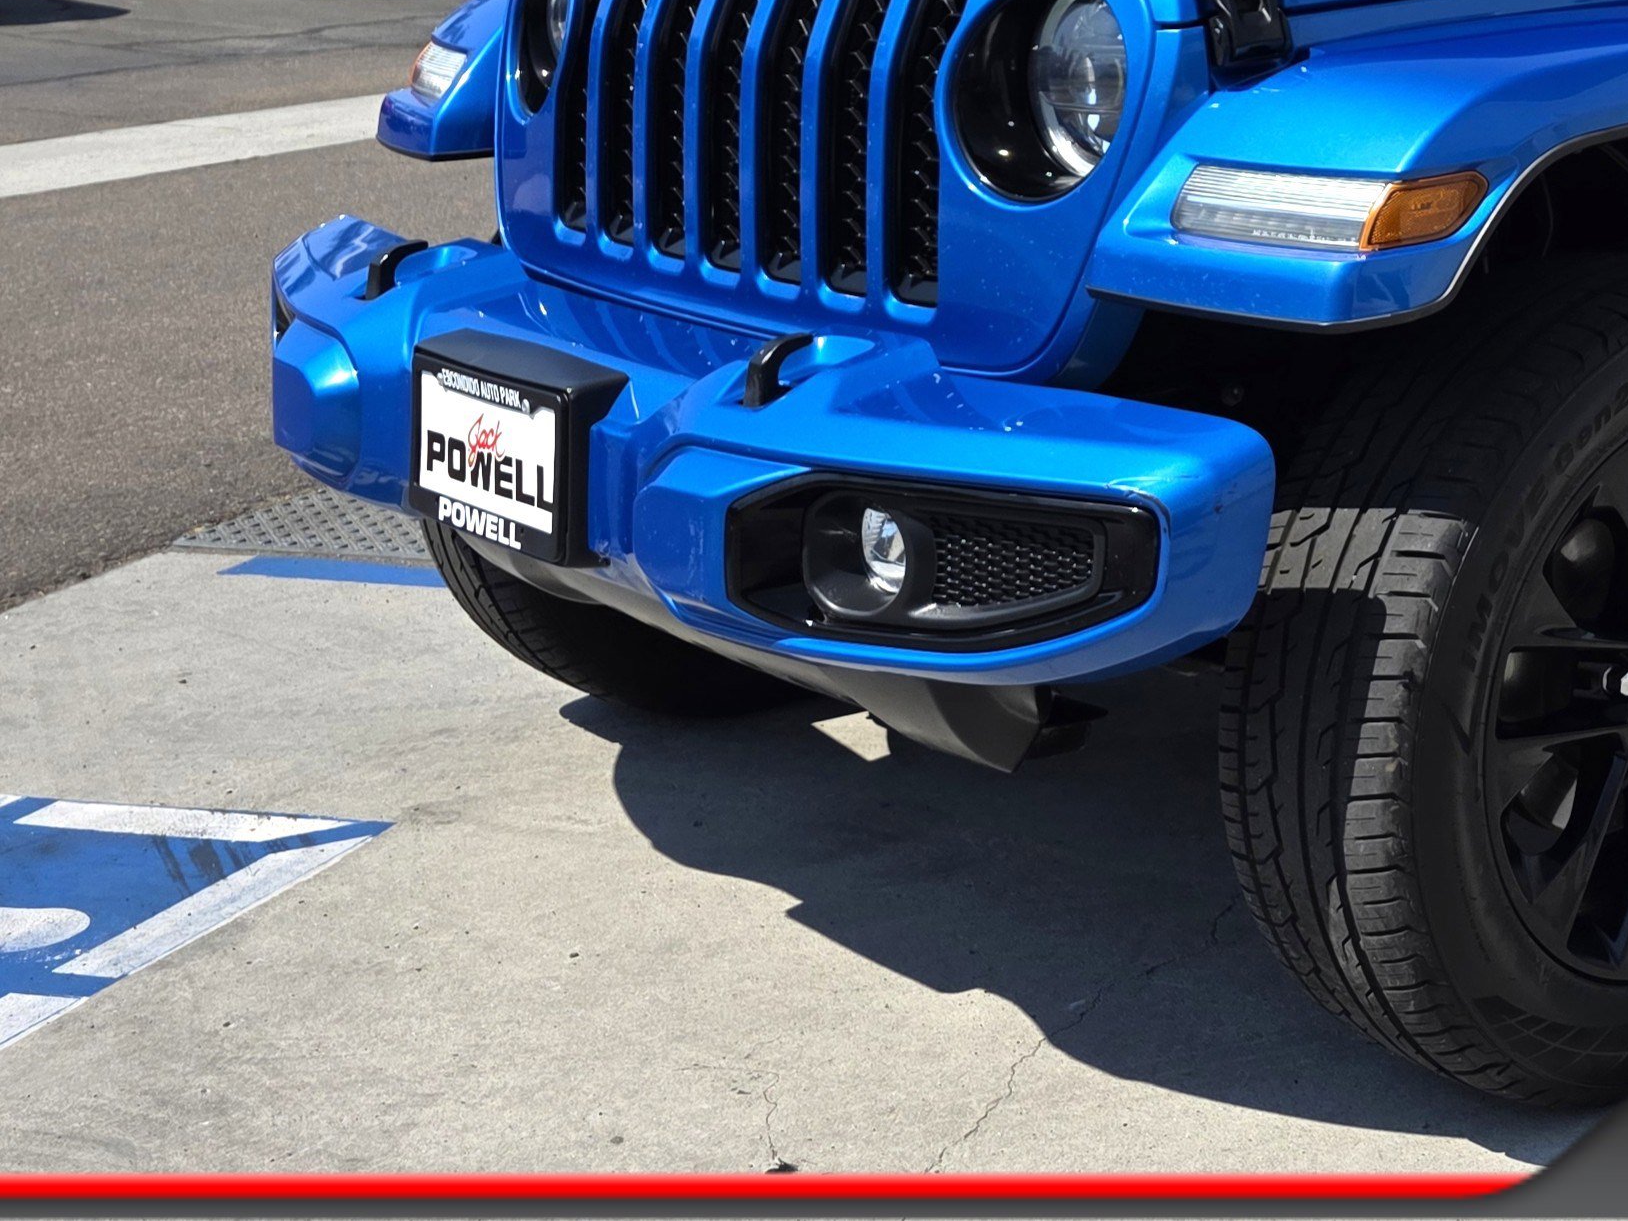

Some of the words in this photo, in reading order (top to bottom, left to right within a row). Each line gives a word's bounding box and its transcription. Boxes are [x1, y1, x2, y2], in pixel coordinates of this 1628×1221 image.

[441, 368, 480, 398] ESCONDIDO
[480, 380, 500, 403] AUTO
[500, 386, 522, 410] PARK
[468, 413, 505, 467] Jack
[426, 429, 555, 513] POWELL
[438, 496, 522, 550] POWELL
